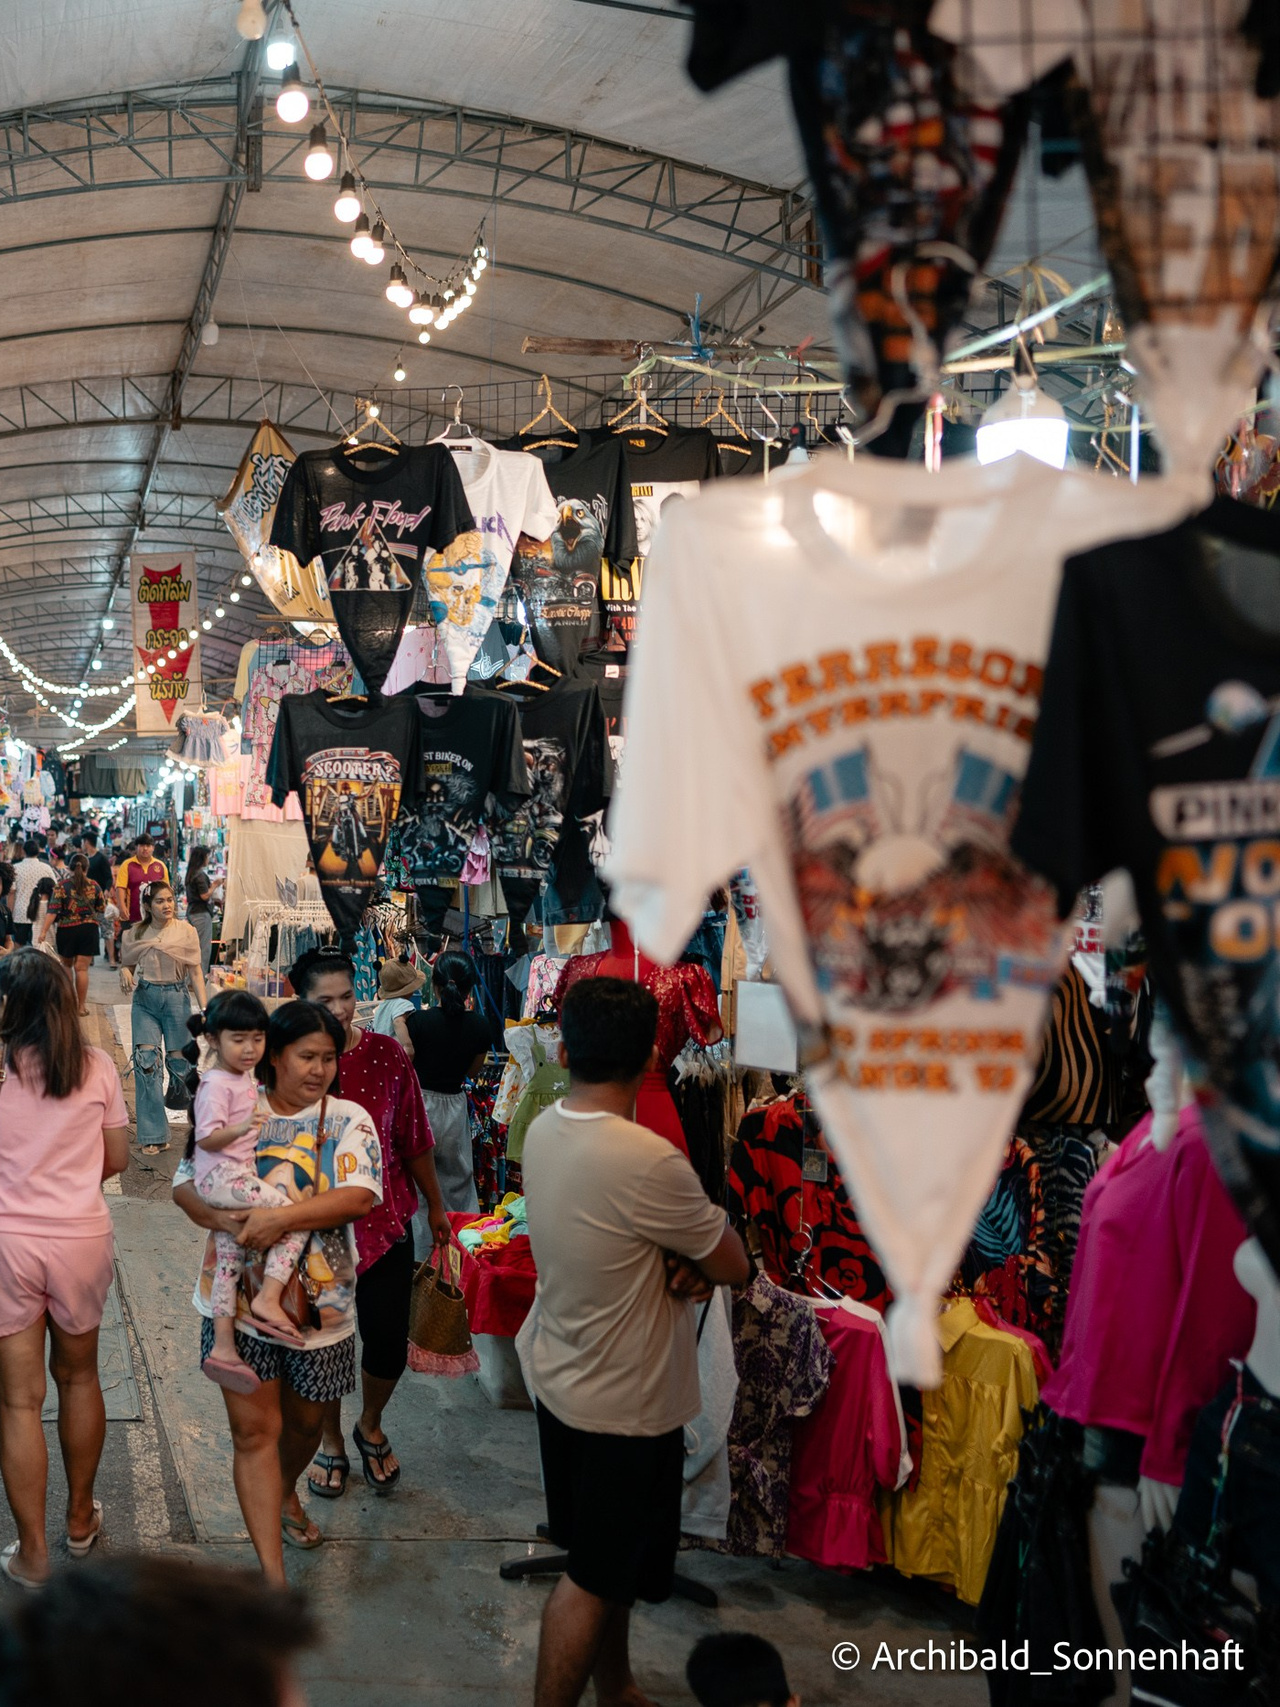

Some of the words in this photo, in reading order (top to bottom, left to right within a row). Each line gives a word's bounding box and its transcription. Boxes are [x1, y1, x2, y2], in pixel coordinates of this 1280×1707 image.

[320, 501, 367, 532] Pink
[368, 500, 432, 539] Floyd
[435, 751, 462, 766] BIKER
[462, 758, 474, 771] ON
